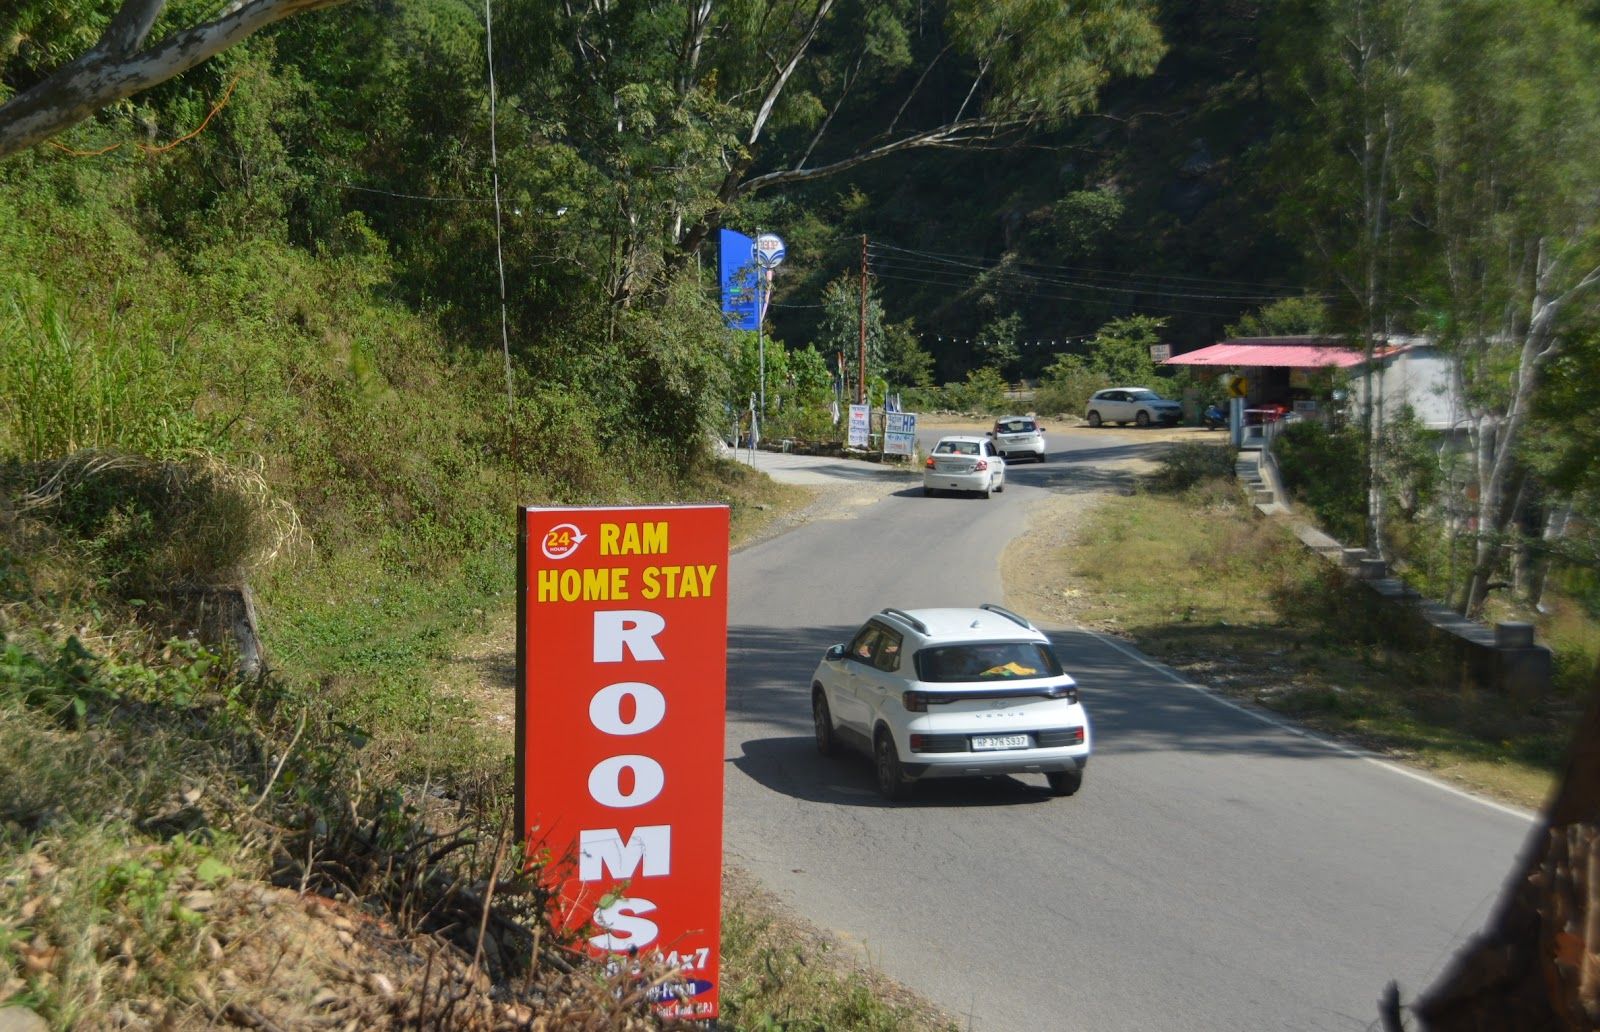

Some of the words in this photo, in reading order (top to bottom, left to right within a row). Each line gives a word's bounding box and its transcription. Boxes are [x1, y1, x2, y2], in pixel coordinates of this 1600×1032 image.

[902, 415, 915, 432] HP
[547, 531, 571, 547] 24
[599, 521, 669, 556] RAM
[537, 567, 630, 603] HOME
[641, 564, 718, 600] STAY
[579, 610, 672, 951] ROOMS
